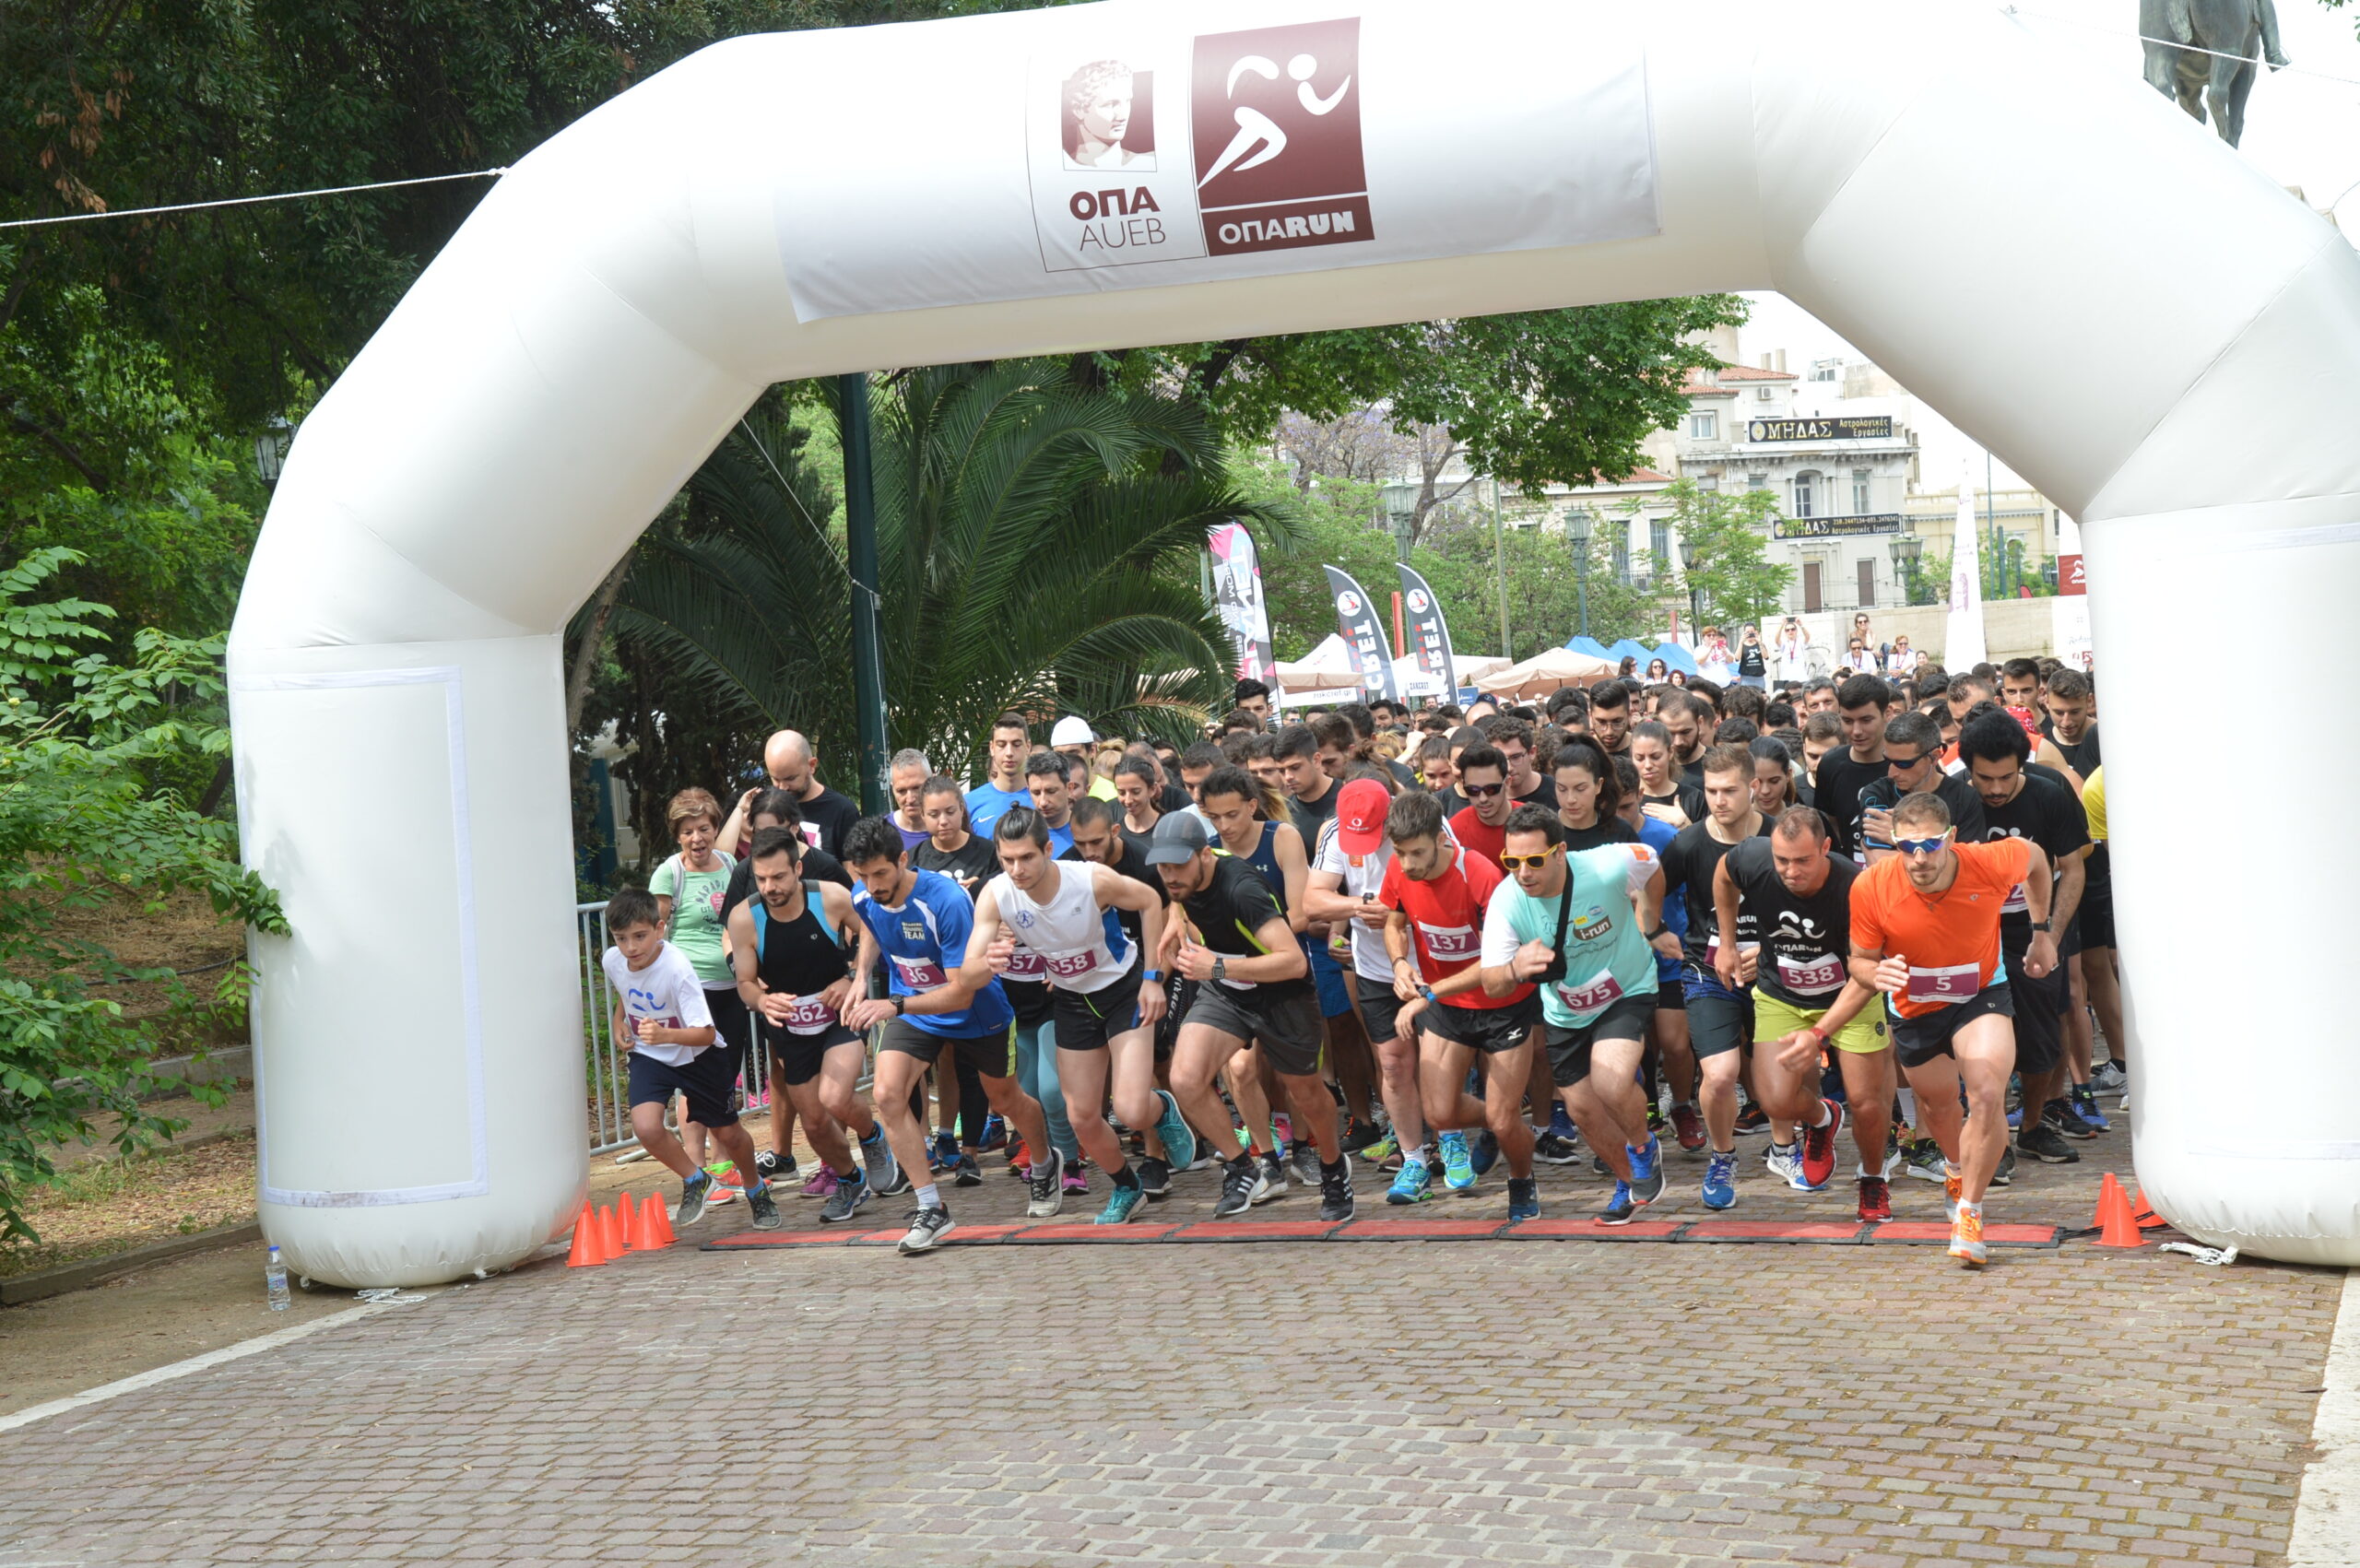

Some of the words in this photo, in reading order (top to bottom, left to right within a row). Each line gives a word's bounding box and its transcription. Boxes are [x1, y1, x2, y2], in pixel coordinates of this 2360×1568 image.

[1069, 186, 1160, 221] ΟΠΑ
[1080, 218, 1166, 252] AUEB
[1767, 421, 1833, 440] ΜΗΔΑΣ
[904, 931, 926, 941] TEAM
[1579, 921, 1611, 940] i-run
[1428, 933, 1467, 950] 137
[1047, 954, 1089, 974] 558
[906, 967, 930, 984] 36
[1788, 966, 1835, 984] 538
[1936, 976, 1953, 991] 5
[1566, 983, 1611, 1008] 675
